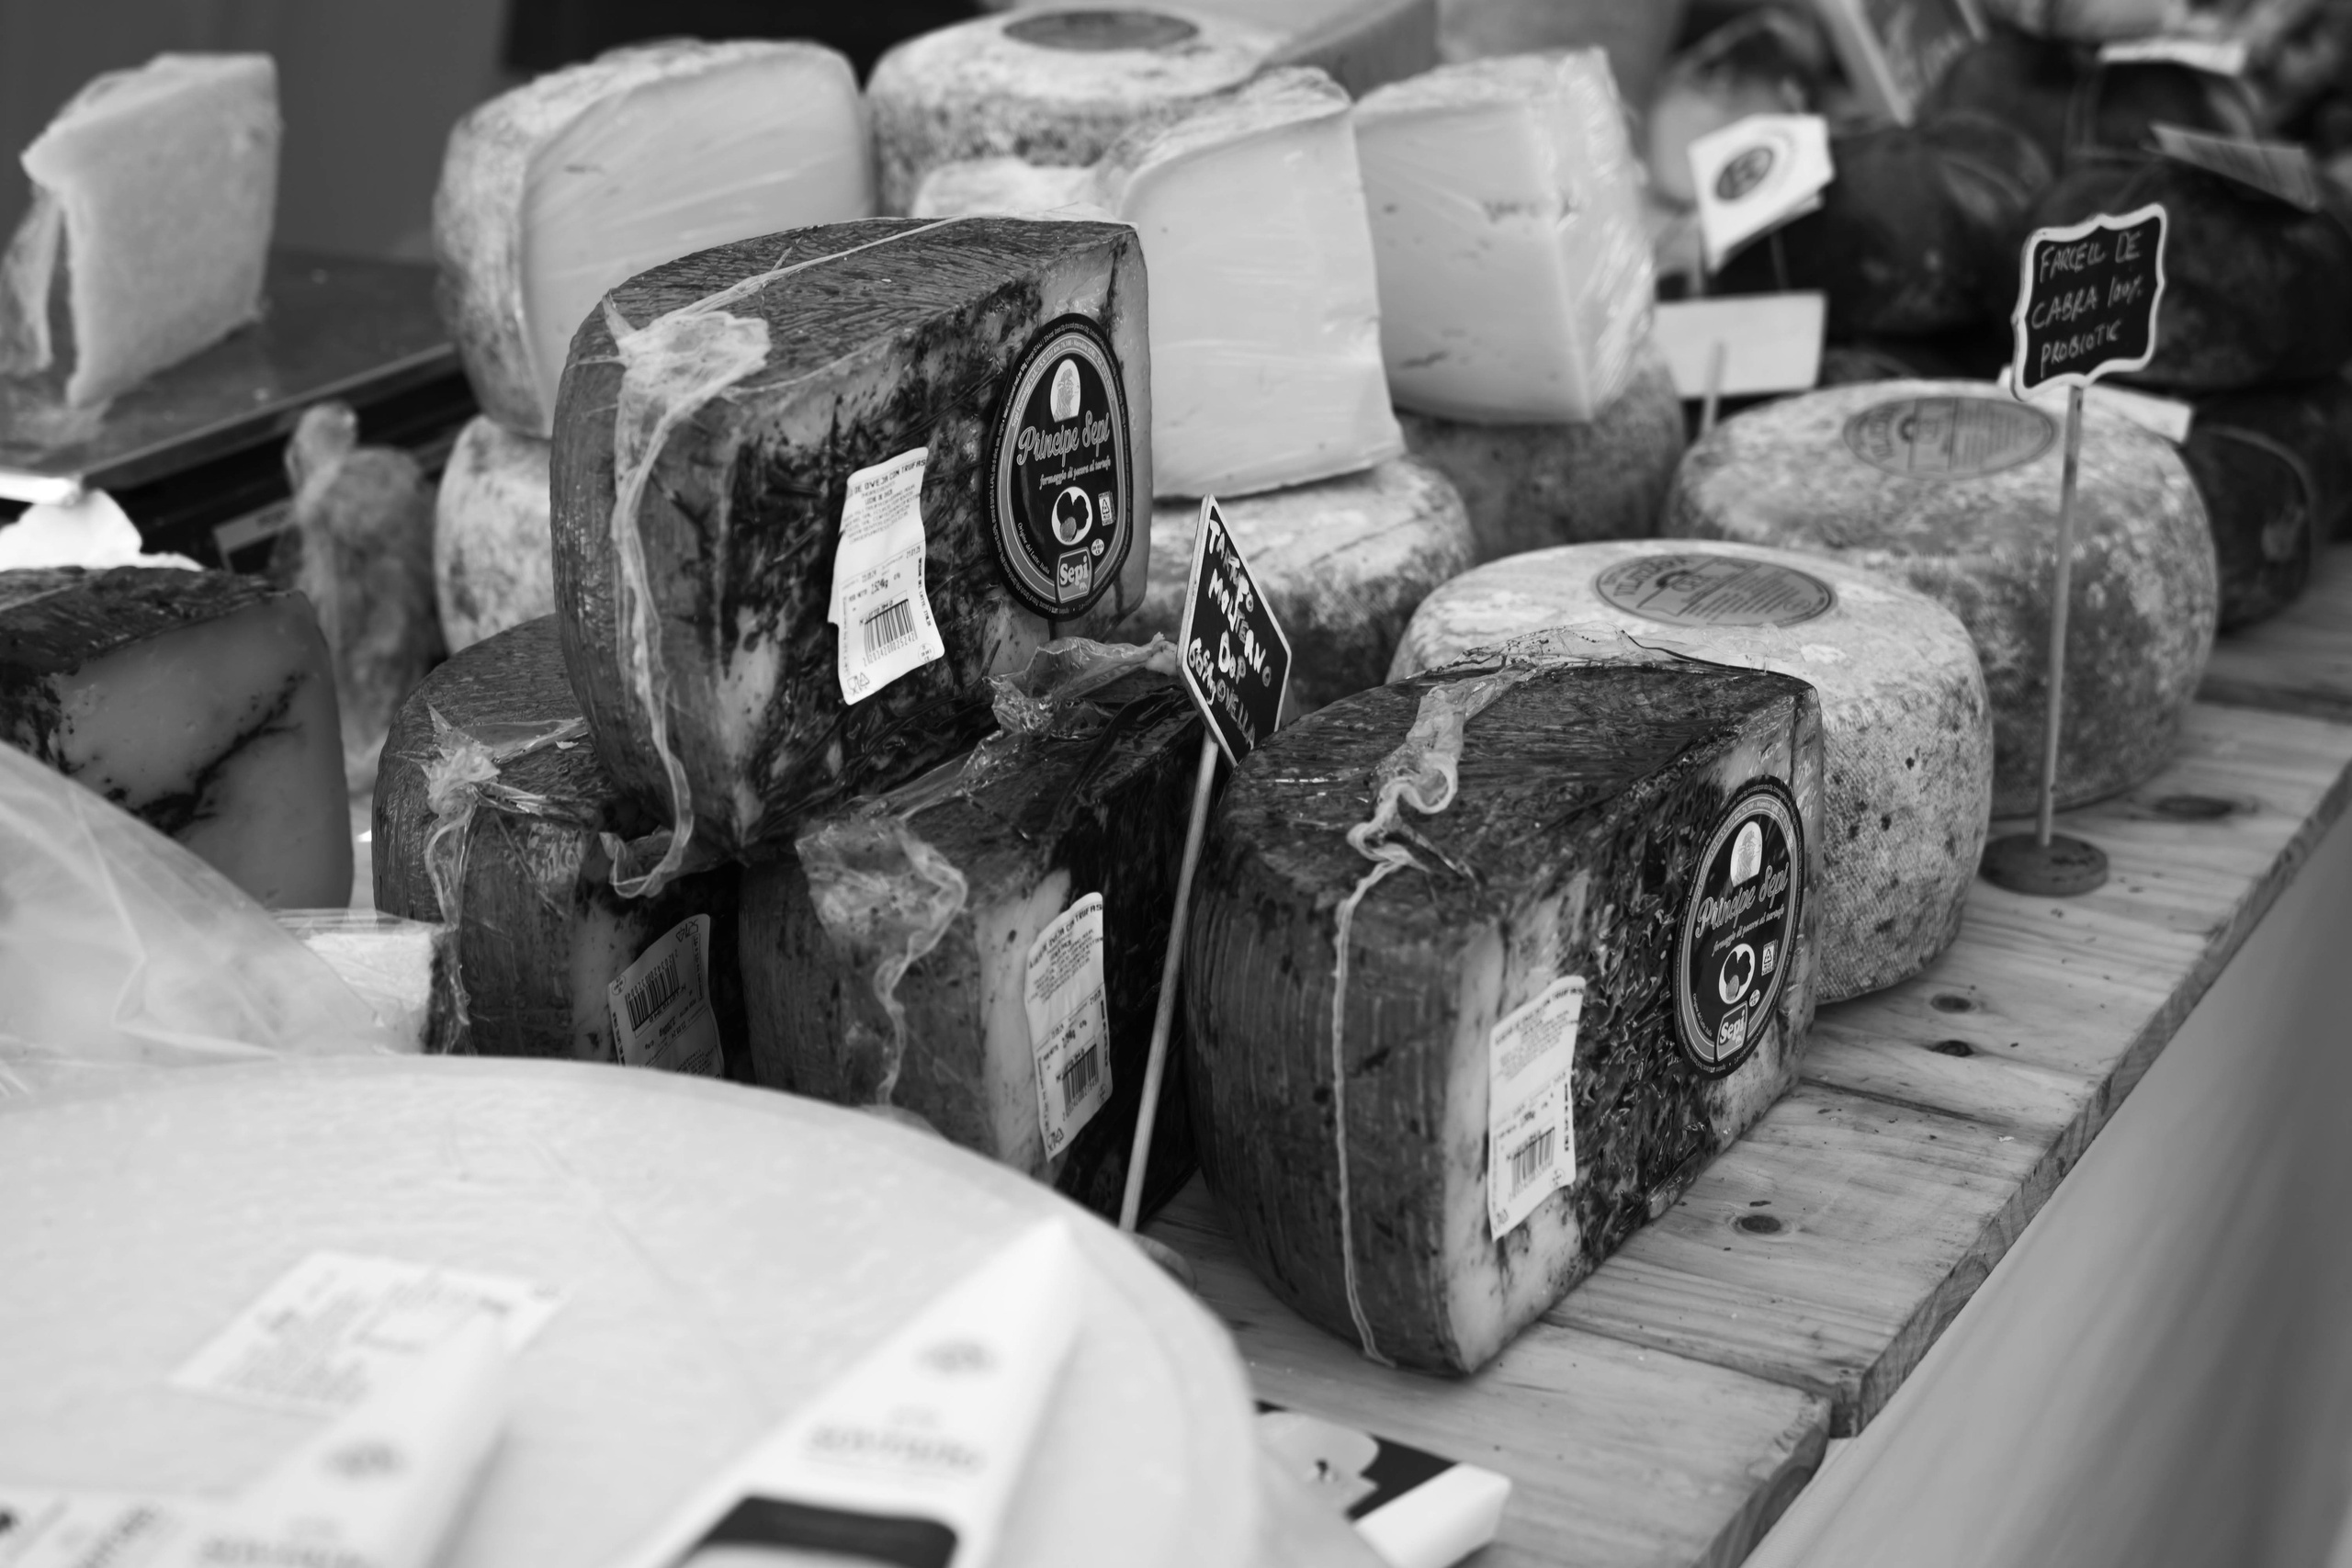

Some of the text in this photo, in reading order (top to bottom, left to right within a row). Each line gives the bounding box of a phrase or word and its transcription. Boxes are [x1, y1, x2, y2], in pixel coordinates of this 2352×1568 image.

[2040, 231, 2143, 283] FARCELL DE
[2031, 275, 2143, 330] CABRA 100%
[2041, 319, 2121, 378] PROBIOTIC
[1016, 410, 1110, 467] Principe Sepi
[1039, 469, 1066, 490] formaggio
[1068, 467, 1073, 479] di
[1073, 465, 1088, 480] pecora
[1090, 458, 1094, 471] al
[1017, 522, 1027, 544] Origine
[1060, 555, 1089, 586] Sepi
[1695, 862, 1789, 939] Principe Sepi
[1712, 931, 1736, 957] formaggio
[1736, 925, 1742, 938] di
[1720, 1009, 1745, 1044] Sepi
